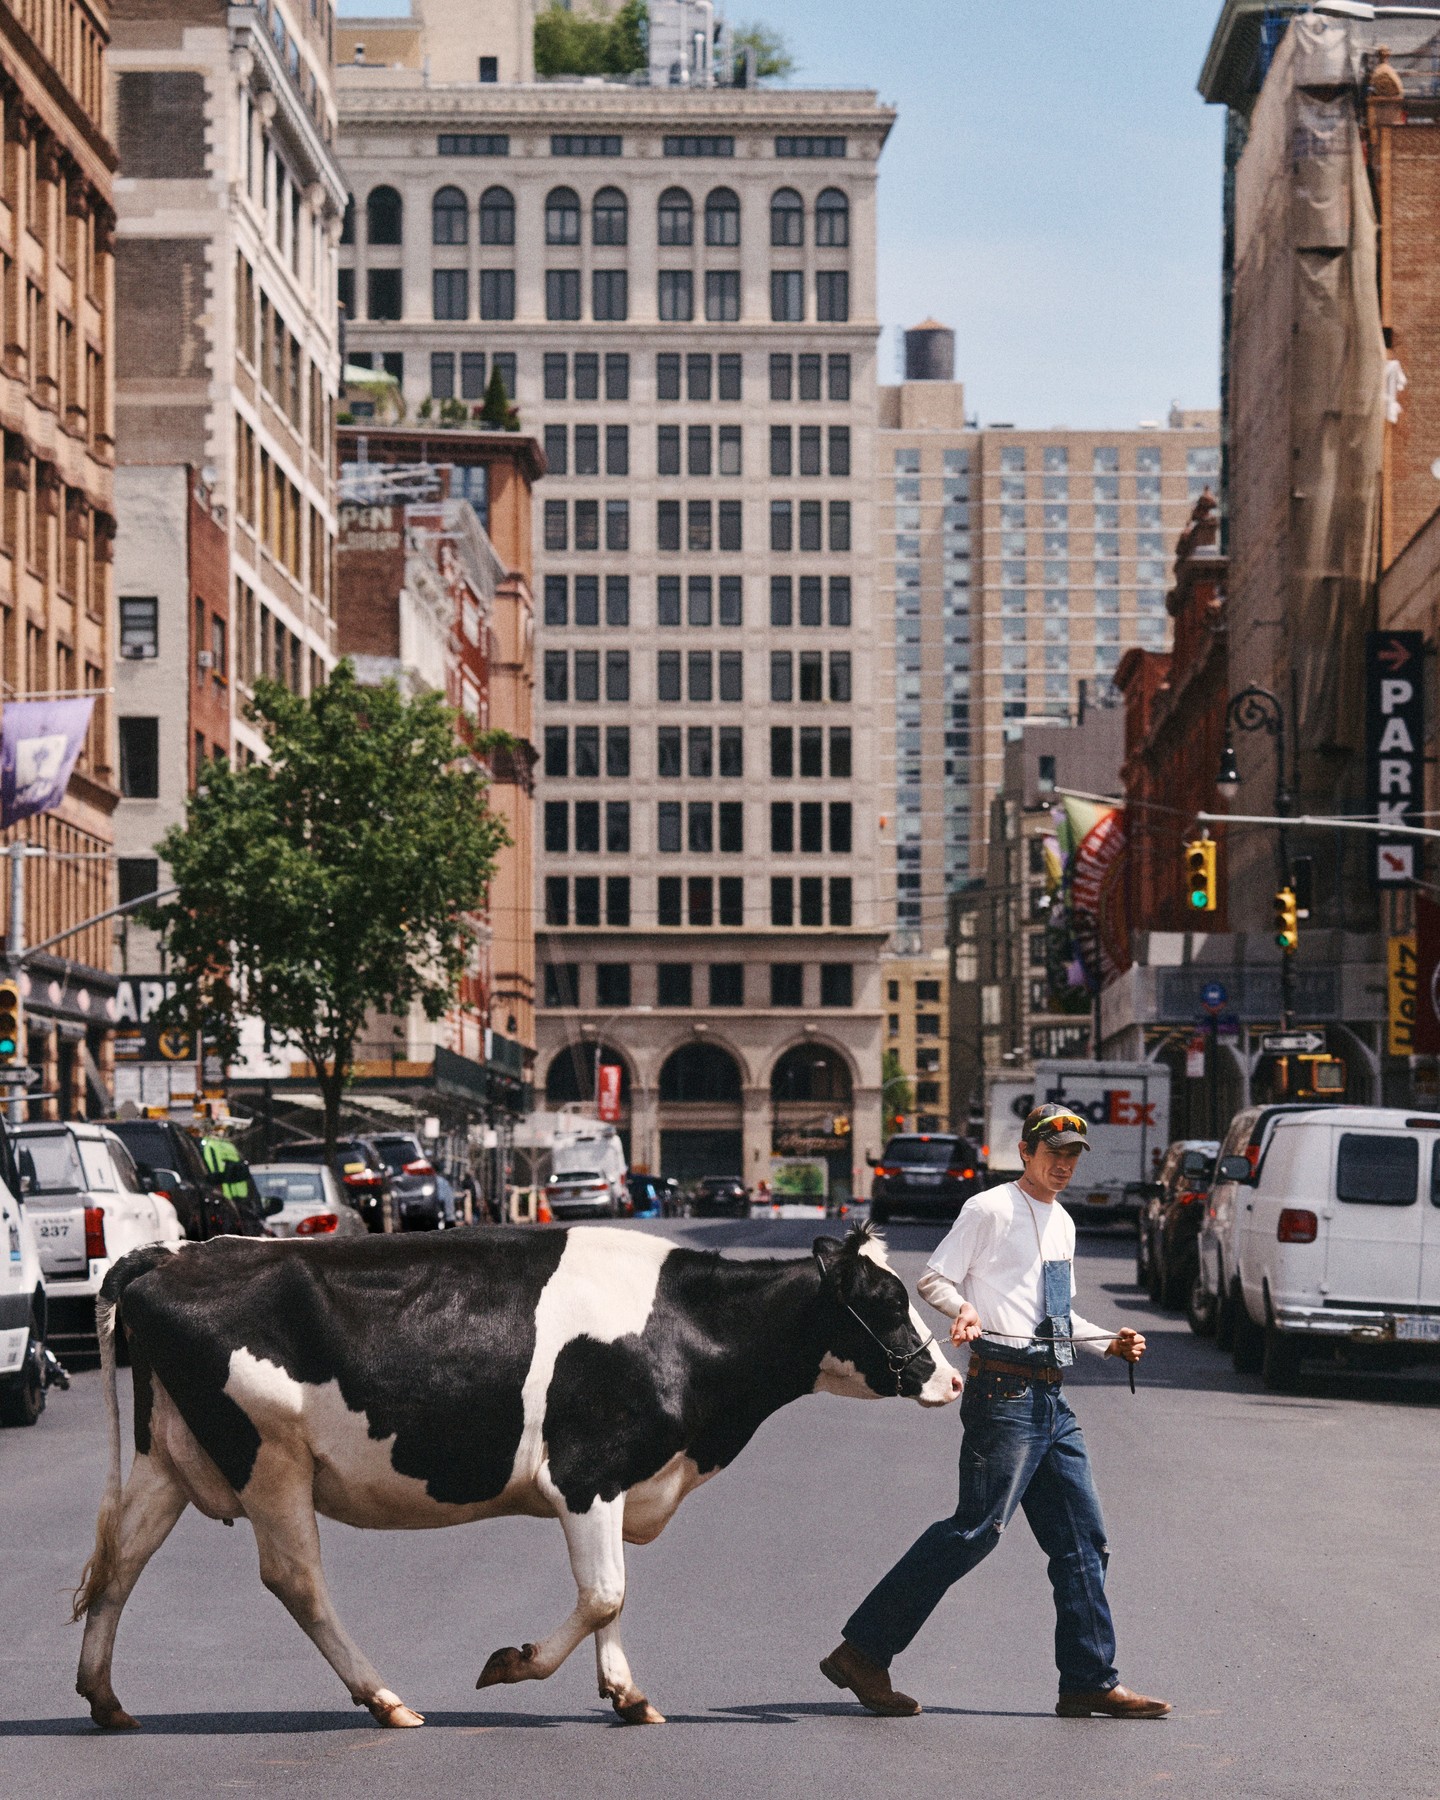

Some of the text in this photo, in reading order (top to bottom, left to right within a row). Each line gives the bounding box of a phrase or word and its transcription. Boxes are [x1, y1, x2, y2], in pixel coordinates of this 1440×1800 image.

[1378, 679, 1414, 836] PARK
[1394, 943, 1417, 1046] Hertz
[1046, 1089, 1156, 1126] FedEx
[40, 1226, 69, 1238] 237
